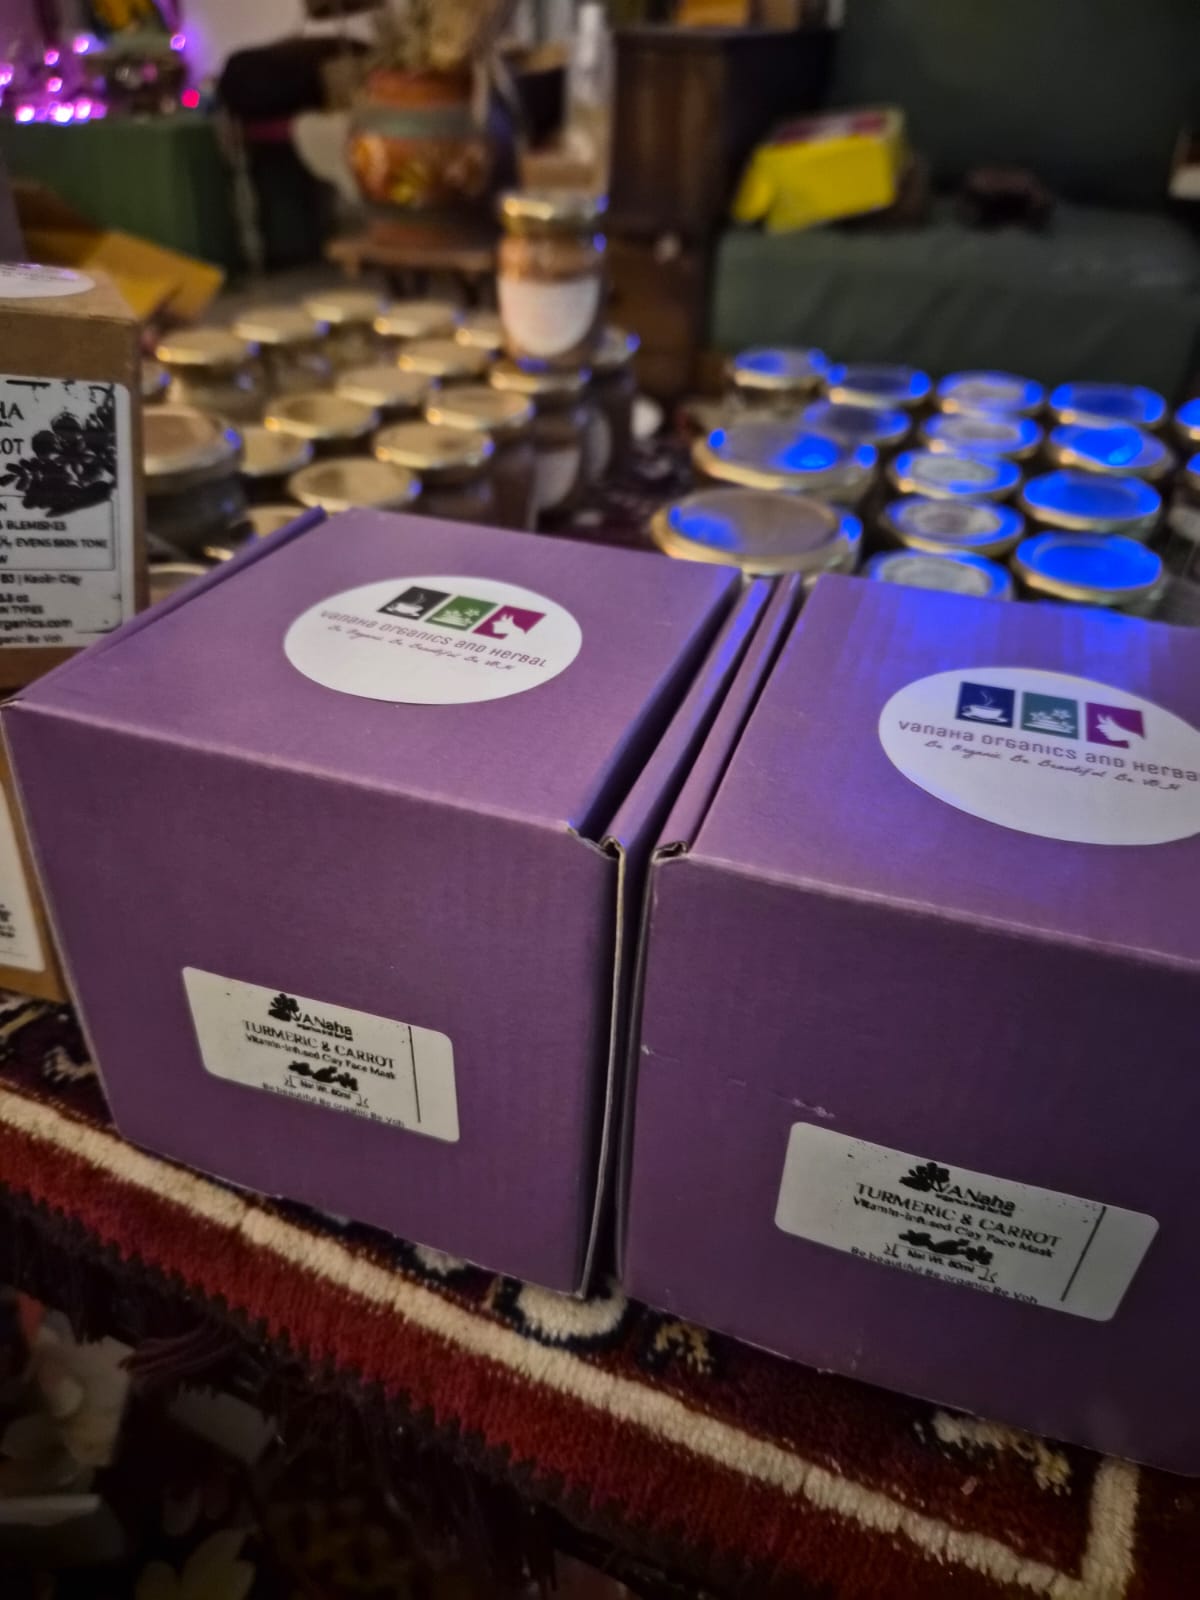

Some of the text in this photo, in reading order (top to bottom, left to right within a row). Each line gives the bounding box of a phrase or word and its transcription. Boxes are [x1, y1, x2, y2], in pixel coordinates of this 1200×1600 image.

[242, 1019, 319, 1048] TURMERIC
[321, 1041, 331, 1052] &
[335, 1045, 396, 1069] CARROT
[345, 1060, 368, 1072] Face
[370, 1066, 396, 1080] Mask
[856, 1182, 957, 1221] TURMERIC
[960, 1213, 973, 1226] &
[978, 1218, 1062, 1247] CARROT
[954, 1226, 981, 1241] Clay
[986, 1233, 1016, 1248] Face
[1018, 1241, 1055, 1258] Mask
